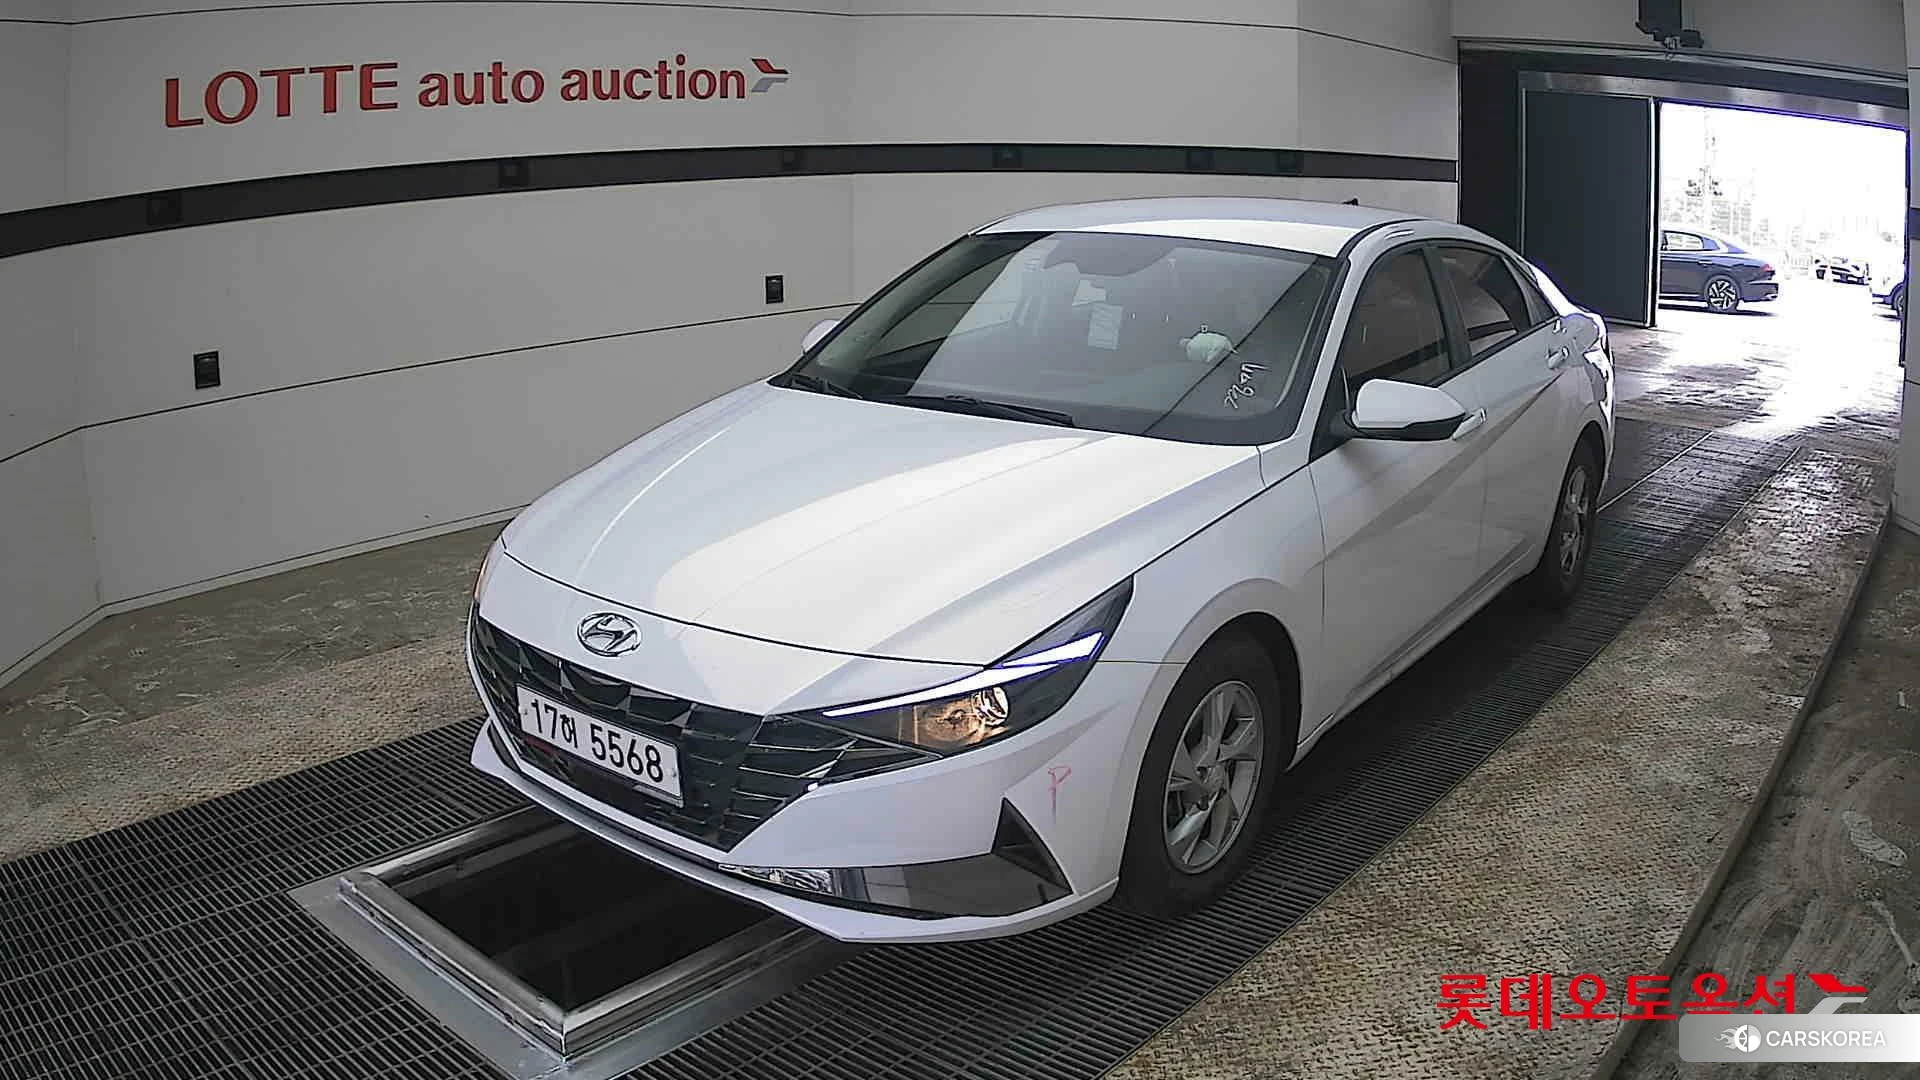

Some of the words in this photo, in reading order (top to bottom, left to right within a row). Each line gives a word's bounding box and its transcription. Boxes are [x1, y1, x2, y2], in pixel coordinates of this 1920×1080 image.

[163, 61, 399, 128] LOTTE
[417, 60, 545, 108] auto
[560, 53, 746, 101] auction
[589, 723, 664, 783] 5568
